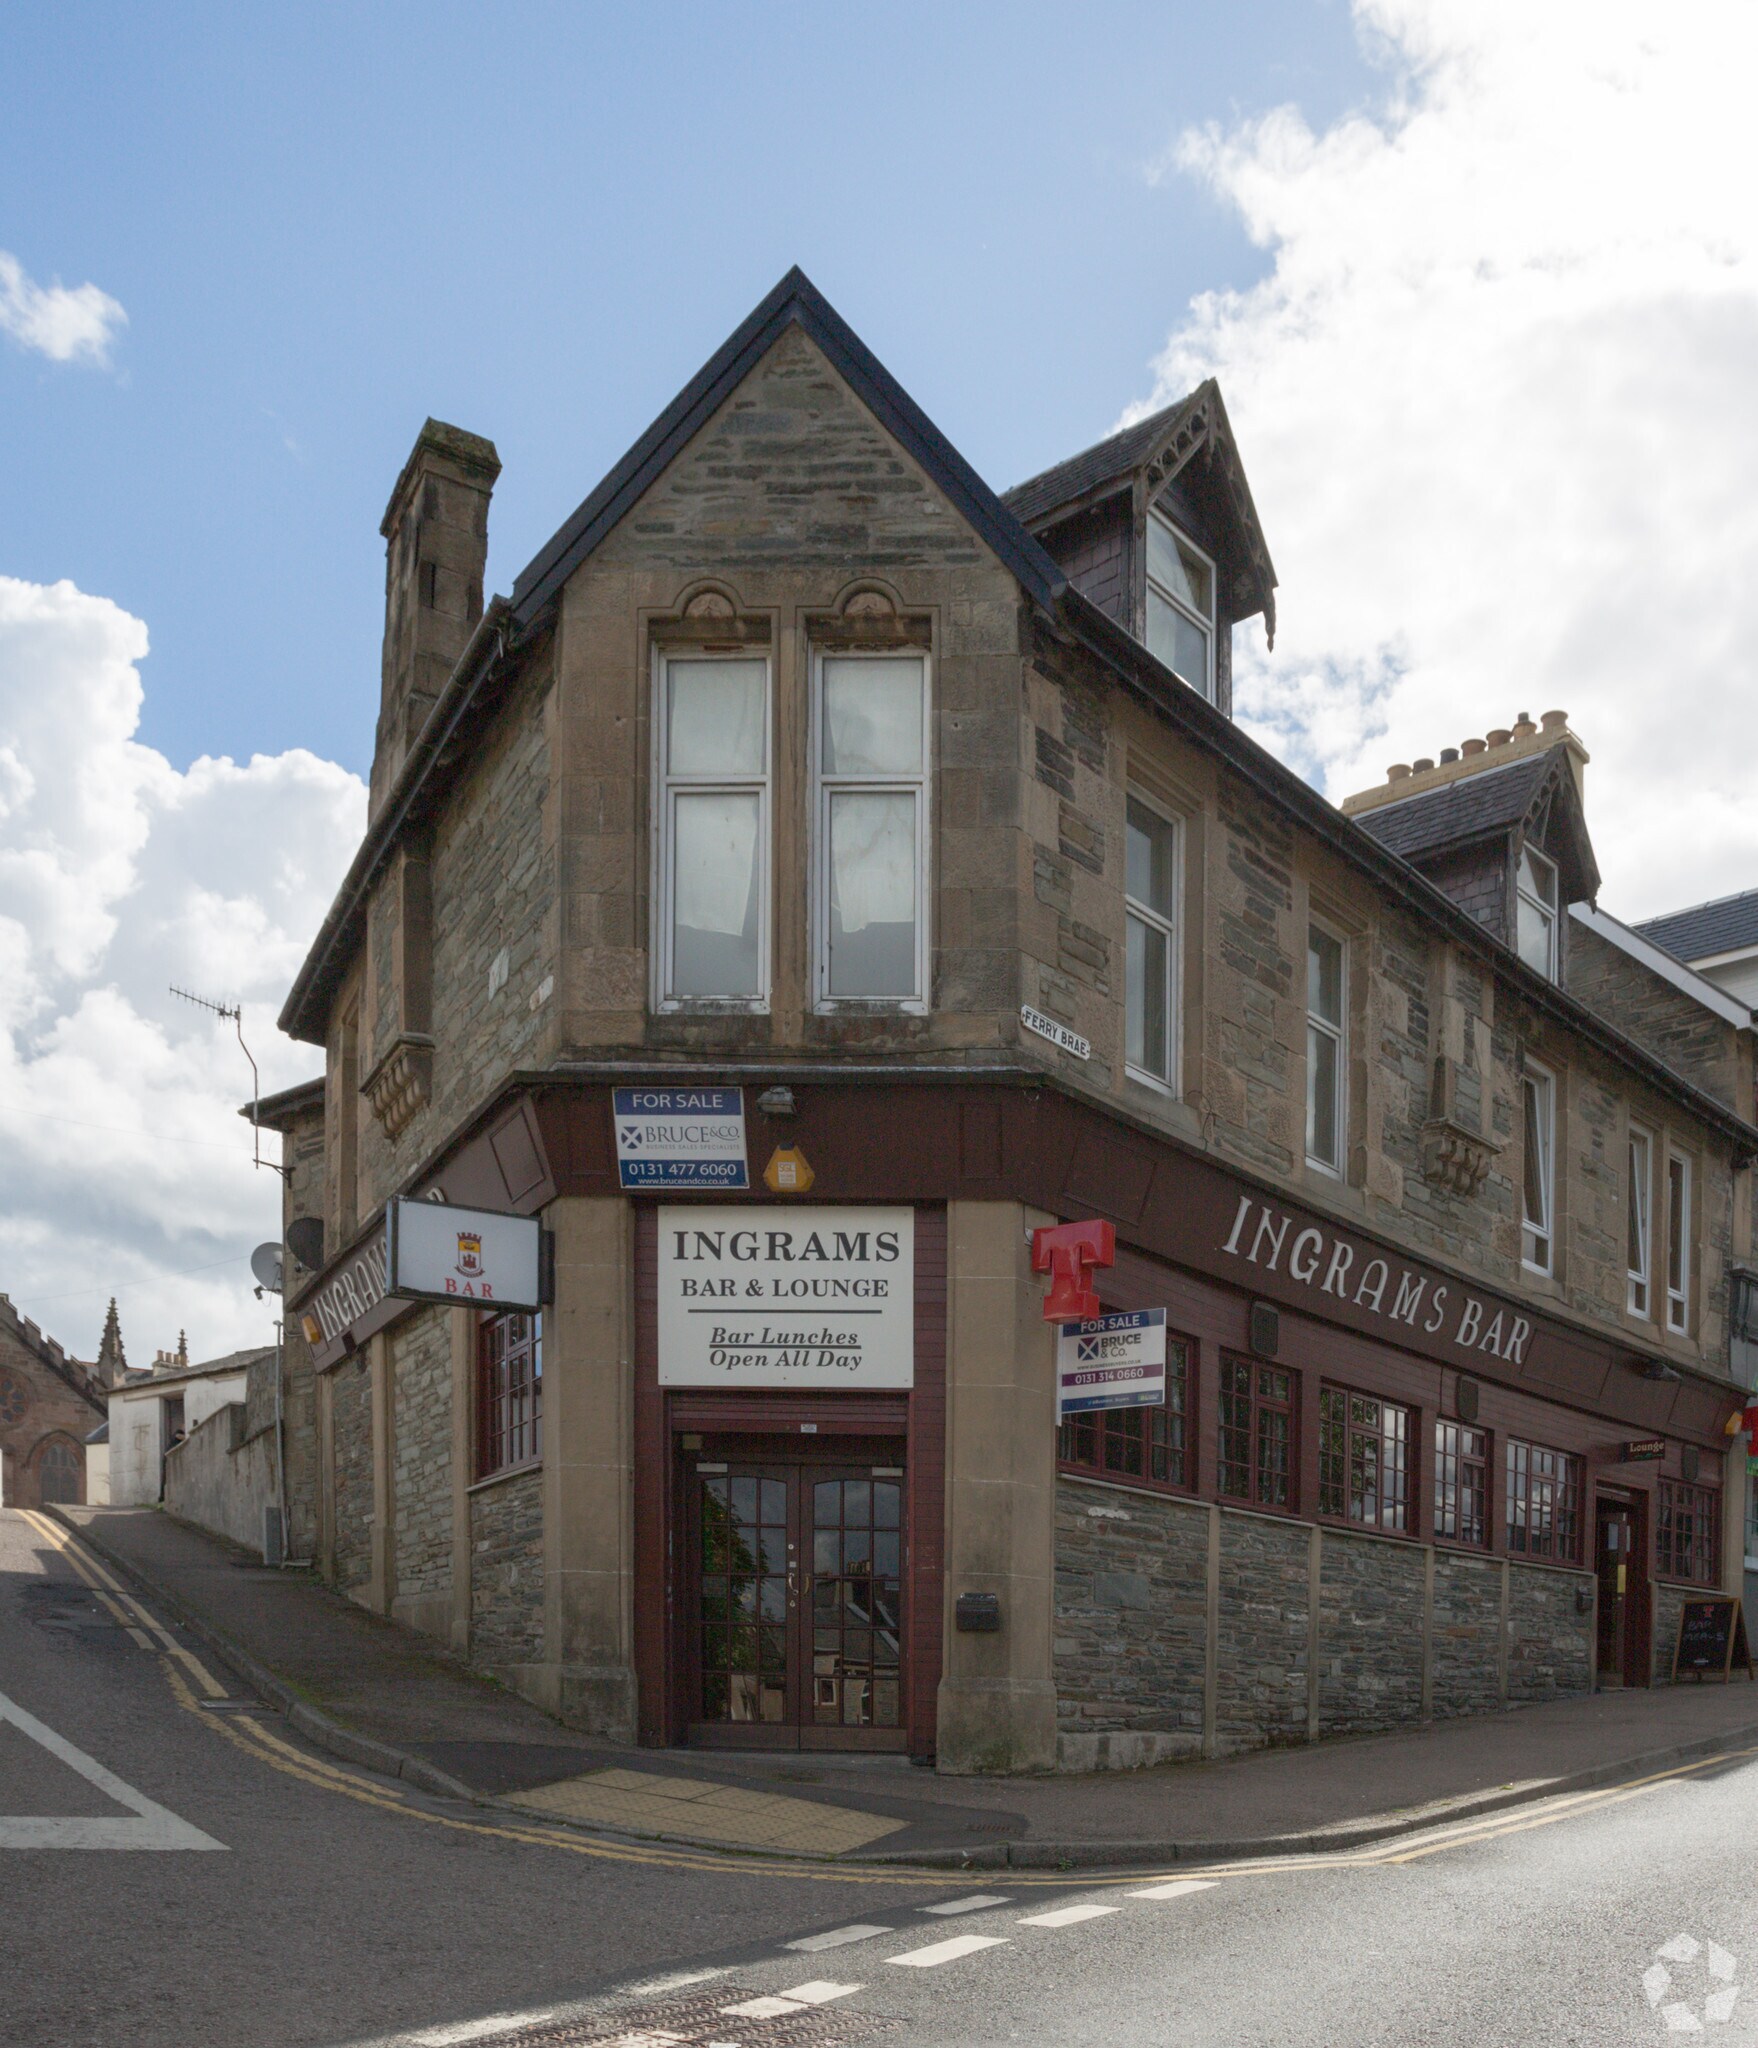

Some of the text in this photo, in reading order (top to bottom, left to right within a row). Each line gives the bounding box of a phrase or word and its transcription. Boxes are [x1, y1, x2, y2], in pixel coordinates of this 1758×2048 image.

[1024, 1010, 1087, 1056] FERRY BRAE
[632, 1094, 723, 1108] FOR SALE
[628, 1163, 737, 1175] 0131 477 6060
[673, 1231, 900, 1262] INGRAMS
[444, 1277, 494, 1299] BAR
[681, 1278, 889, 1298] BAR & LOUNGE
[1221, 1195, 1530, 1364] INGRAMS BAR
[1080, 1314, 1141, 1334] FOR SALE
[710, 1327, 858, 1345] Bar Lunches
[1101, 1333, 1142, 1348] BRUCE
[709, 1350, 862, 1371] Open All Day
[1101, 1348, 1109, 1359] &
[1075, 1368, 1144, 1385] 0131 314 0660
[1630, 1441, 1665, 1453] Lounge
